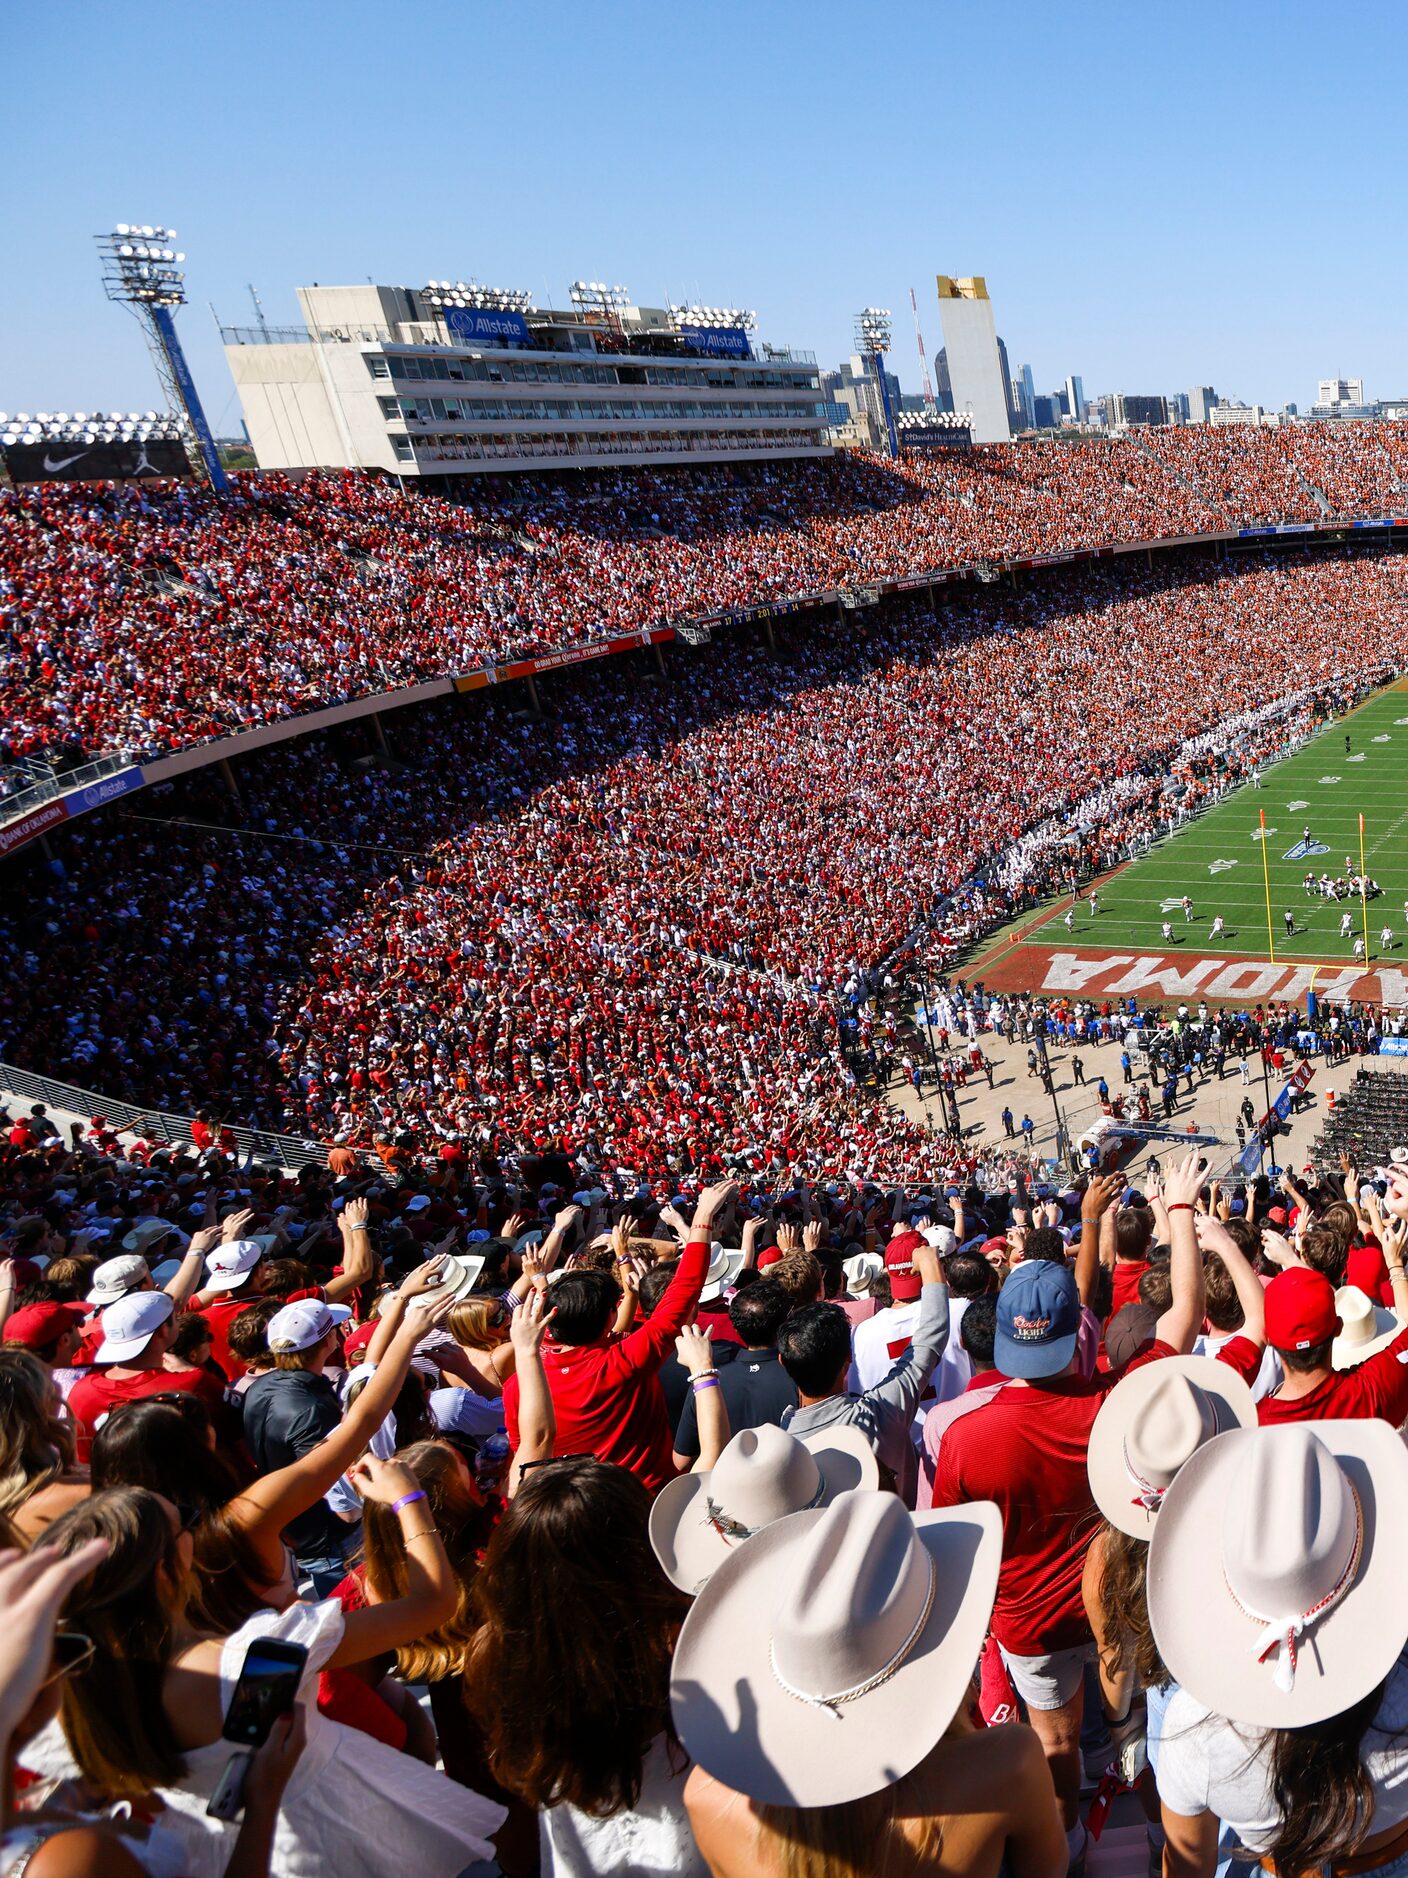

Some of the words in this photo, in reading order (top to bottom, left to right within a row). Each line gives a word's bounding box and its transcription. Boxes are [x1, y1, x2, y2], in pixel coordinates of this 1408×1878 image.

[476, 317, 521, 336] Allstate
[707, 334, 744, 348] Allstate
[757, 608, 771, 619] 2:01
[791, 603, 799, 612] 14
[100, 779, 128, 800] Allstate
[1018, 1327, 1045, 1336] LIGHT
[990, 1703, 1020, 1723] BA
